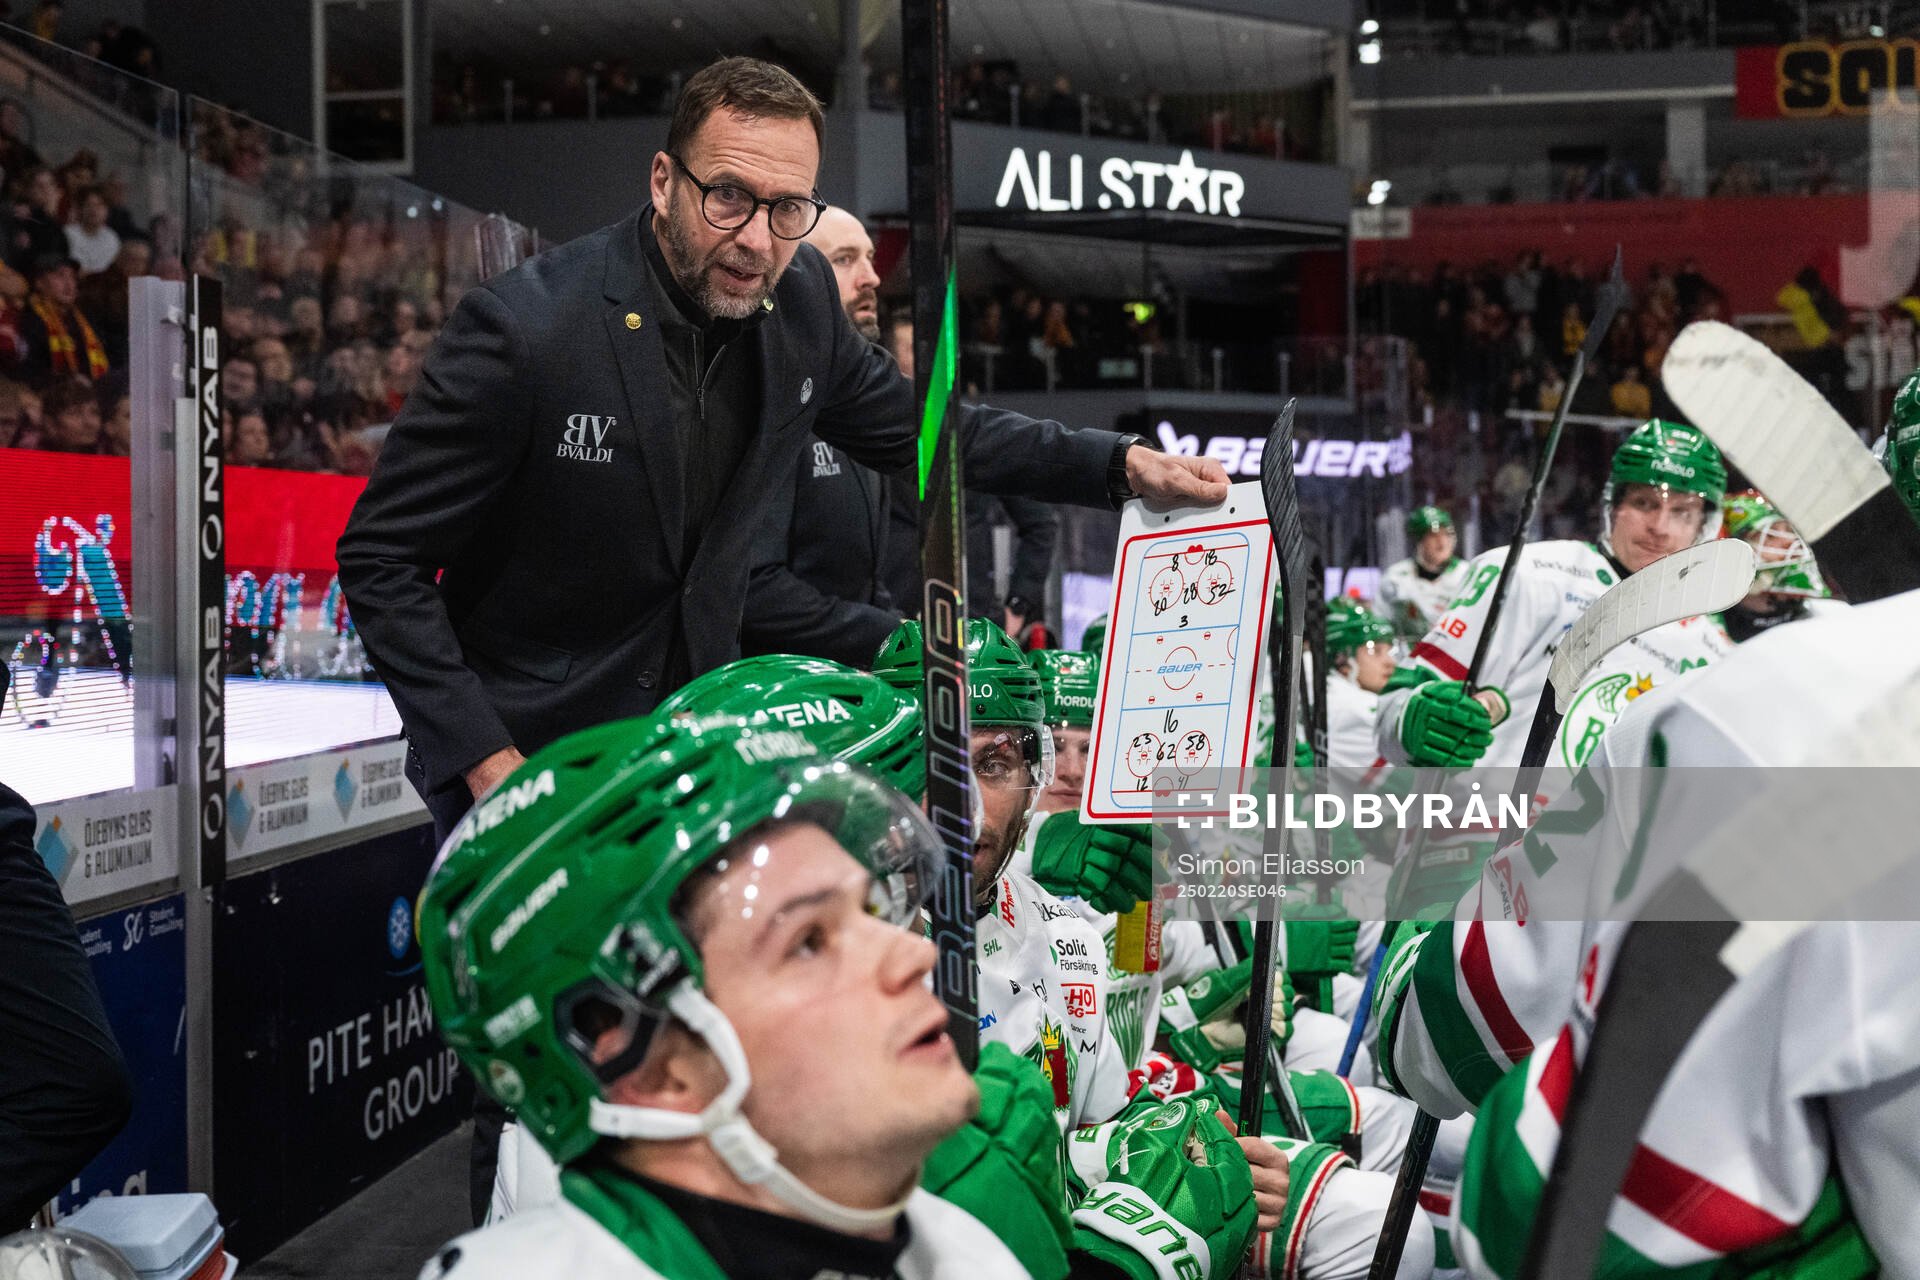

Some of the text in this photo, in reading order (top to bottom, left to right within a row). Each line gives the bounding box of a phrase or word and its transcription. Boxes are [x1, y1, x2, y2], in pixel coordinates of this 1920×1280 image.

[1098, 149, 1245, 217] STAR
[556, 444, 613, 463] BVALDI
[1207, 583, 1236, 605] 52
[1178, 615, 1189, 628] 3
[1054, 694, 1096, 708] NORDL
[751, 699, 854, 728] ATENA
[1163, 709, 1179, 733] 16
[1133, 733, 1151, 748] 23
[1185, 733, 1205, 750] 58
[1156, 742, 1176, 760] 62
[1136, 777, 1149, 792] 12
[1056, 938, 1088, 956] Solid
[1060, 959, 1099, 975] Försäkring
[308, 1013, 372, 1094] PITE
[364, 1047, 460, 1140] GROUP
